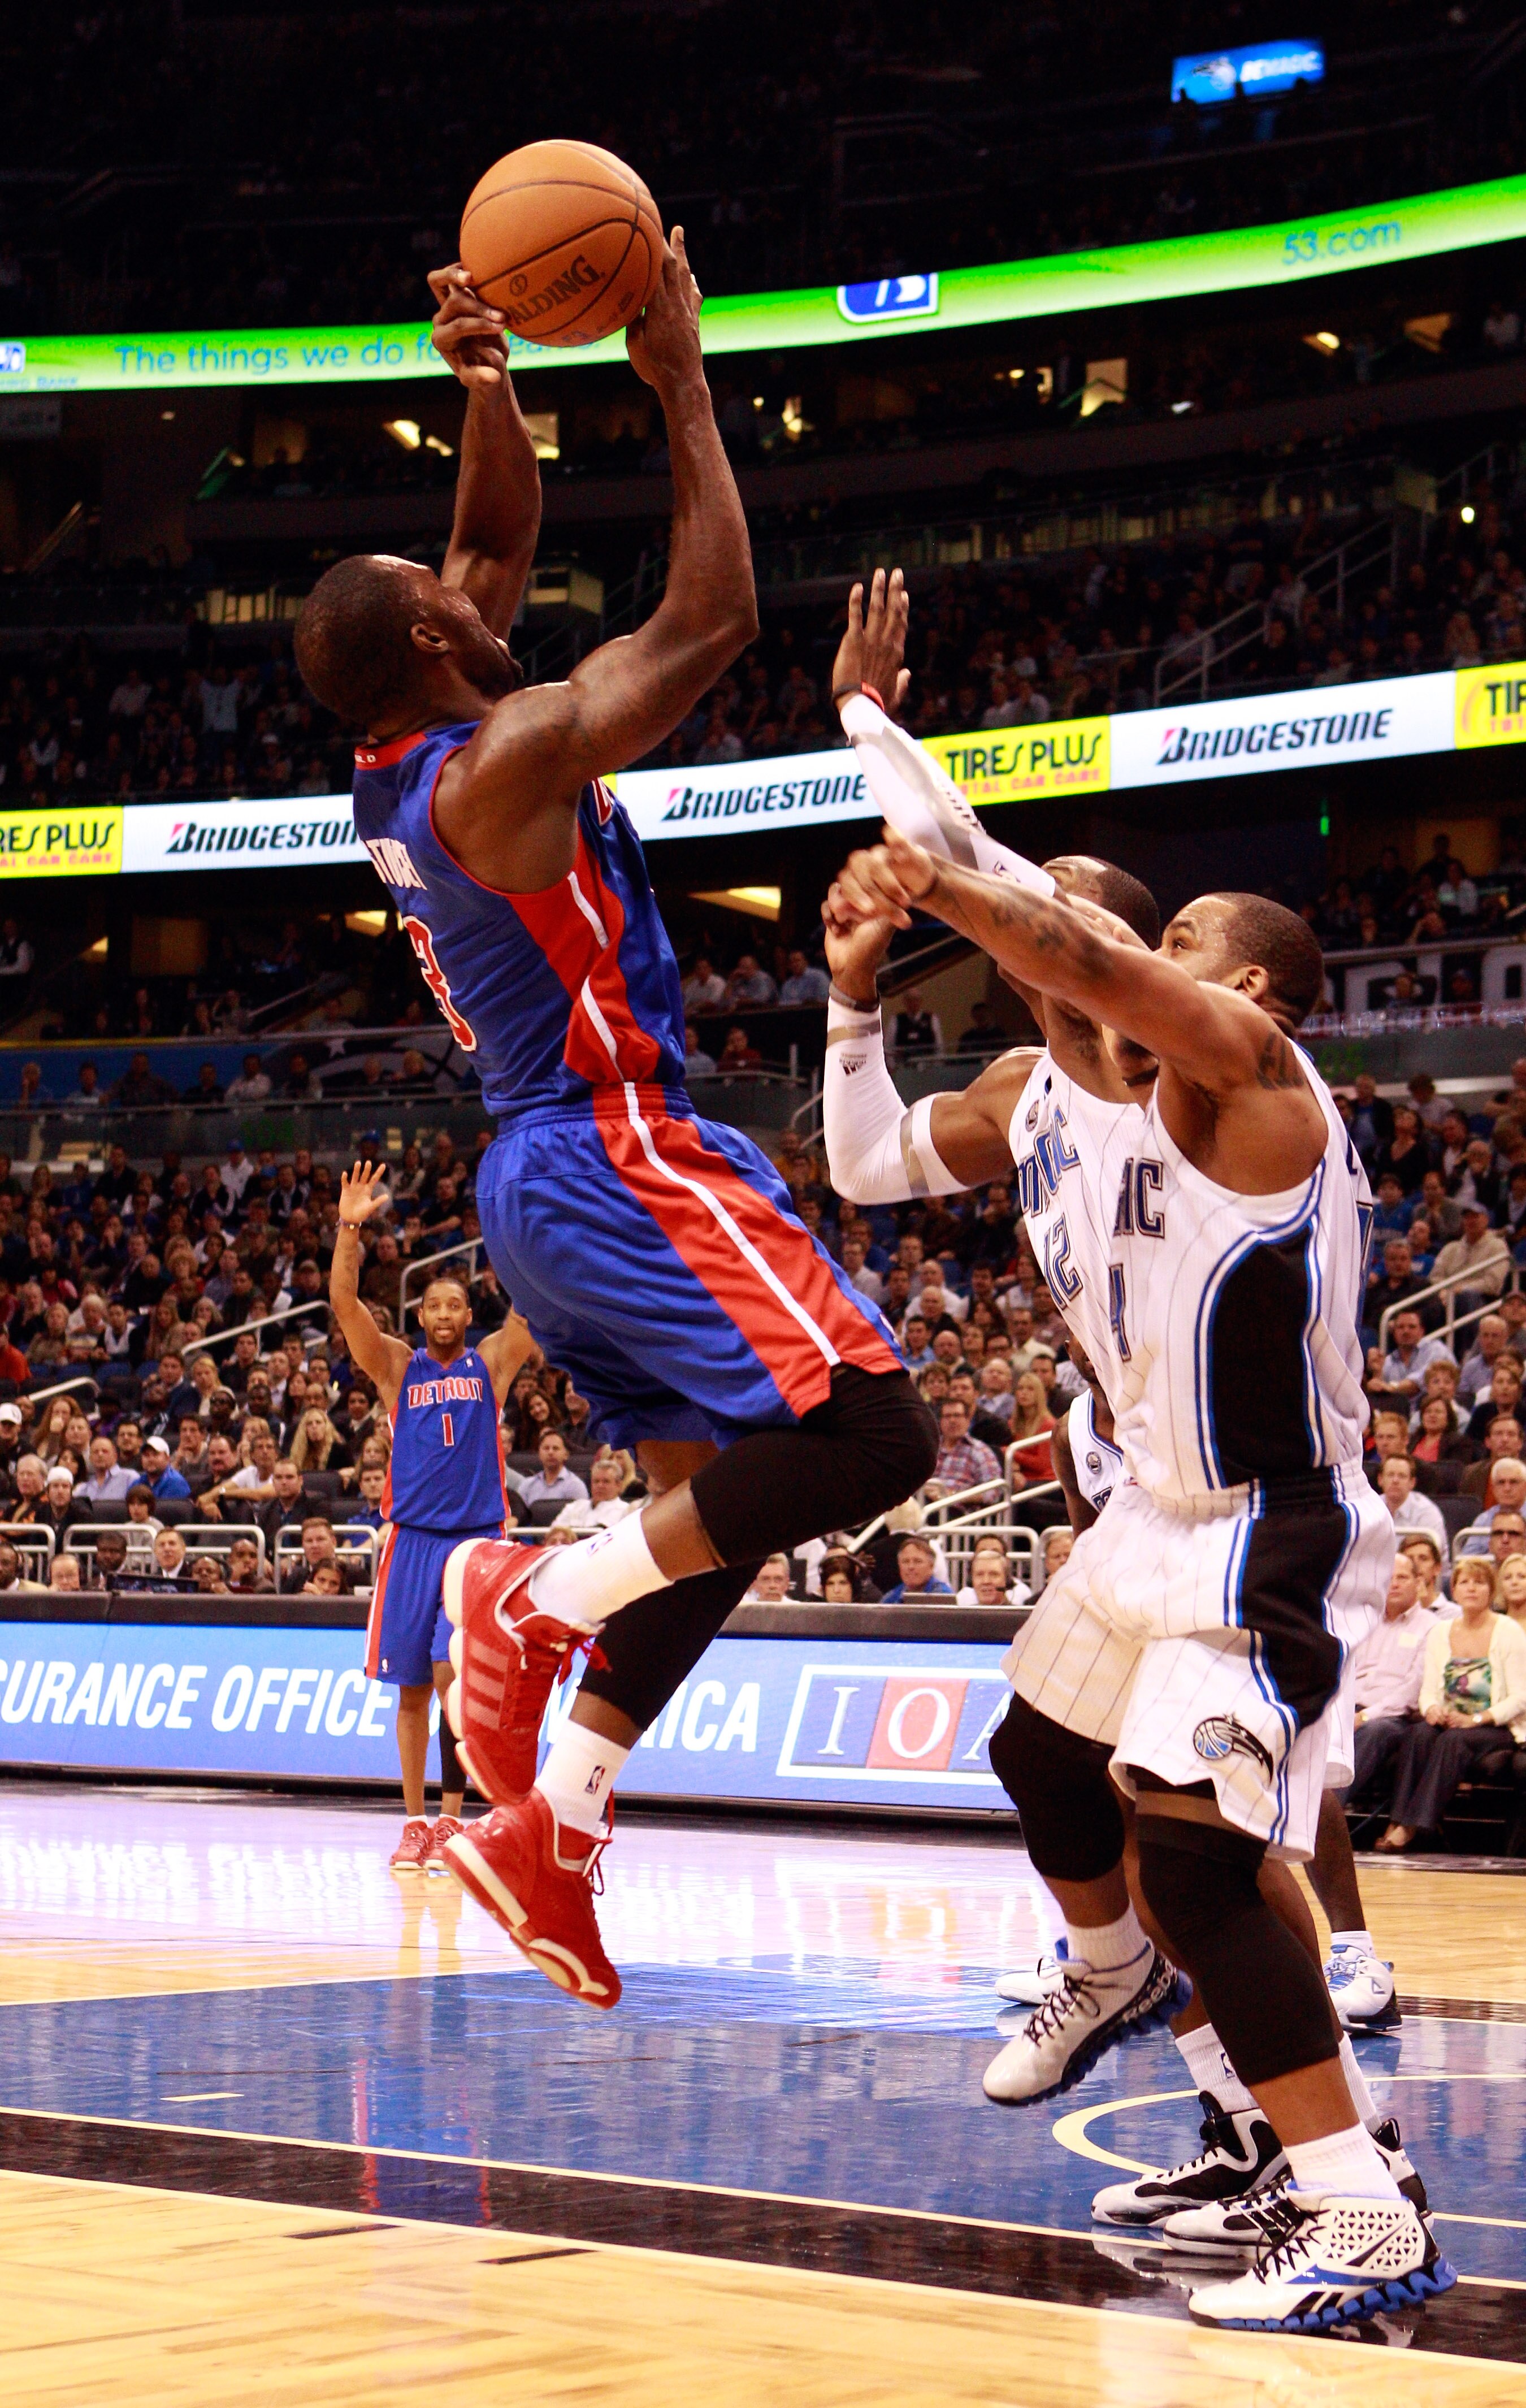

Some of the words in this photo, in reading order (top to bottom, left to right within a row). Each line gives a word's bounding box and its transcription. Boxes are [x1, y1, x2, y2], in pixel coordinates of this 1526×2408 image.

[1281, 221, 1401, 266] 53.com
[115, 345, 175, 374] The
[188, 342, 289, 375] things
[302, 344, 349, 367] we
[361, 337, 404, 366] do
[416, 332, 444, 362] fo
[946, 742, 1024, 781] TIRES
[1030, 733, 1102, 772] PLUS
[1155, 708, 1393, 765] BRIDGESTONE
[661, 773, 869, 822] BRIDGESTONE
[46, 822, 115, 852] PLUS
[165, 820, 358, 855] BRIDGESTON
[1043, 1212, 1084, 1311] 12
[407, 1376, 483, 1410] DETROIT
[441, 1413, 455, 1446] 1
[211, 1665, 393, 1737] OFFICE
